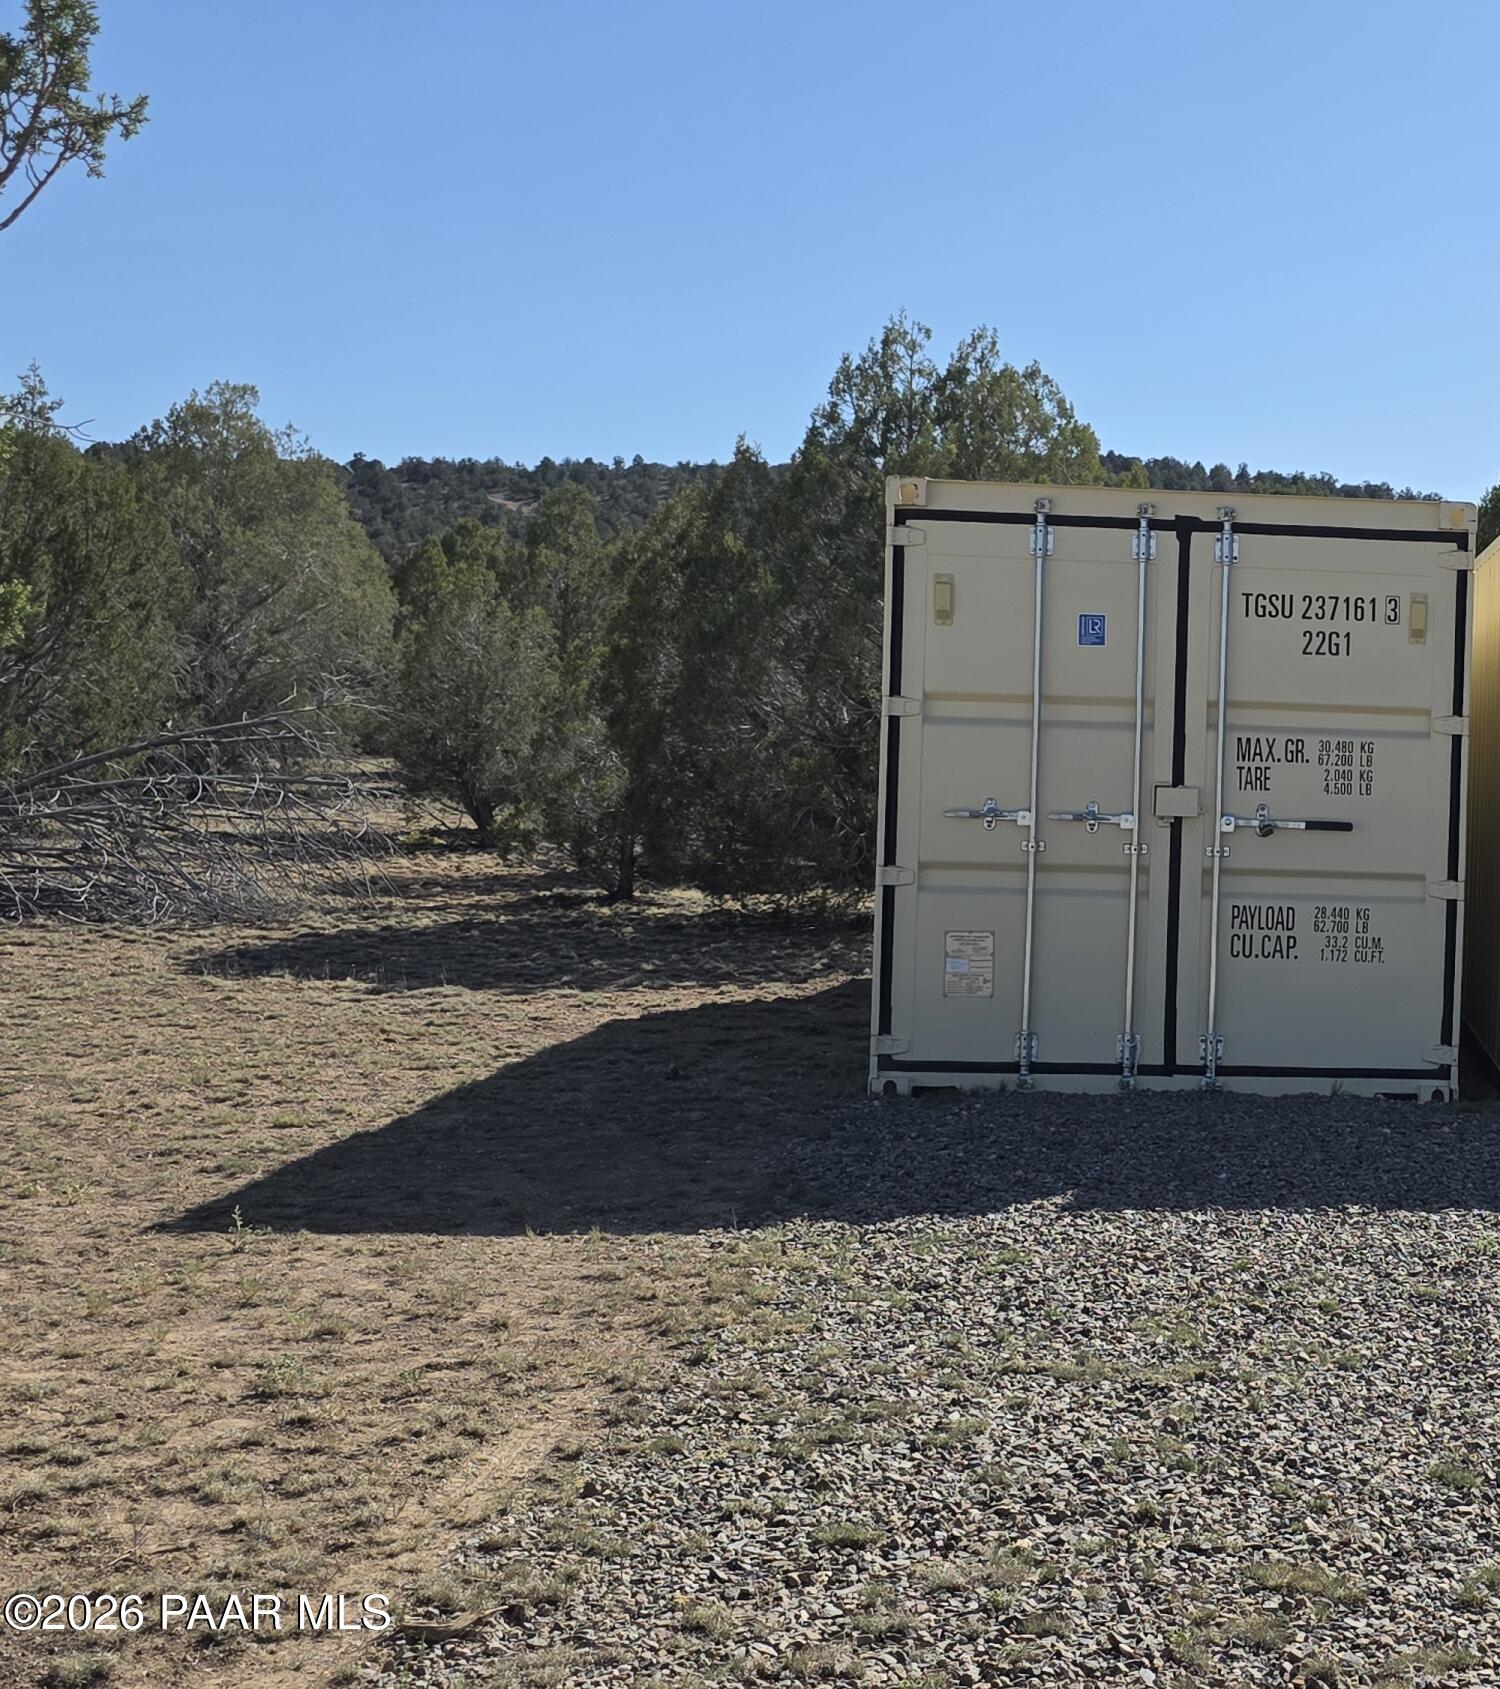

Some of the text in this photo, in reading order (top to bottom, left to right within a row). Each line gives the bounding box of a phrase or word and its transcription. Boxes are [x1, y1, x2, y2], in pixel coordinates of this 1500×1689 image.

[1242, 592, 1398, 623] TGSU 237161 3
[1302, 630, 1351, 657] 22G1
[1318, 740, 1375, 754] 30.480 KG
[1317, 754, 1373, 768] 67.200 LB
[1236, 766, 1271, 791] TARE
[1323, 768, 1374, 783] 2.040 KG
[1323, 782, 1372, 796] 4.500 LB
[1231, 904, 1296, 931] PAYLOAD
[1314, 906, 1370, 921] 28.440 KG
[1313, 920, 1369, 934] 62.700 LB
[1230, 933, 1298, 960] CU.CAP.
[1324, 935, 1384, 950] 33.2 CU.M.
[1320, 948, 1385, 964] 1.172 CU.FT.
